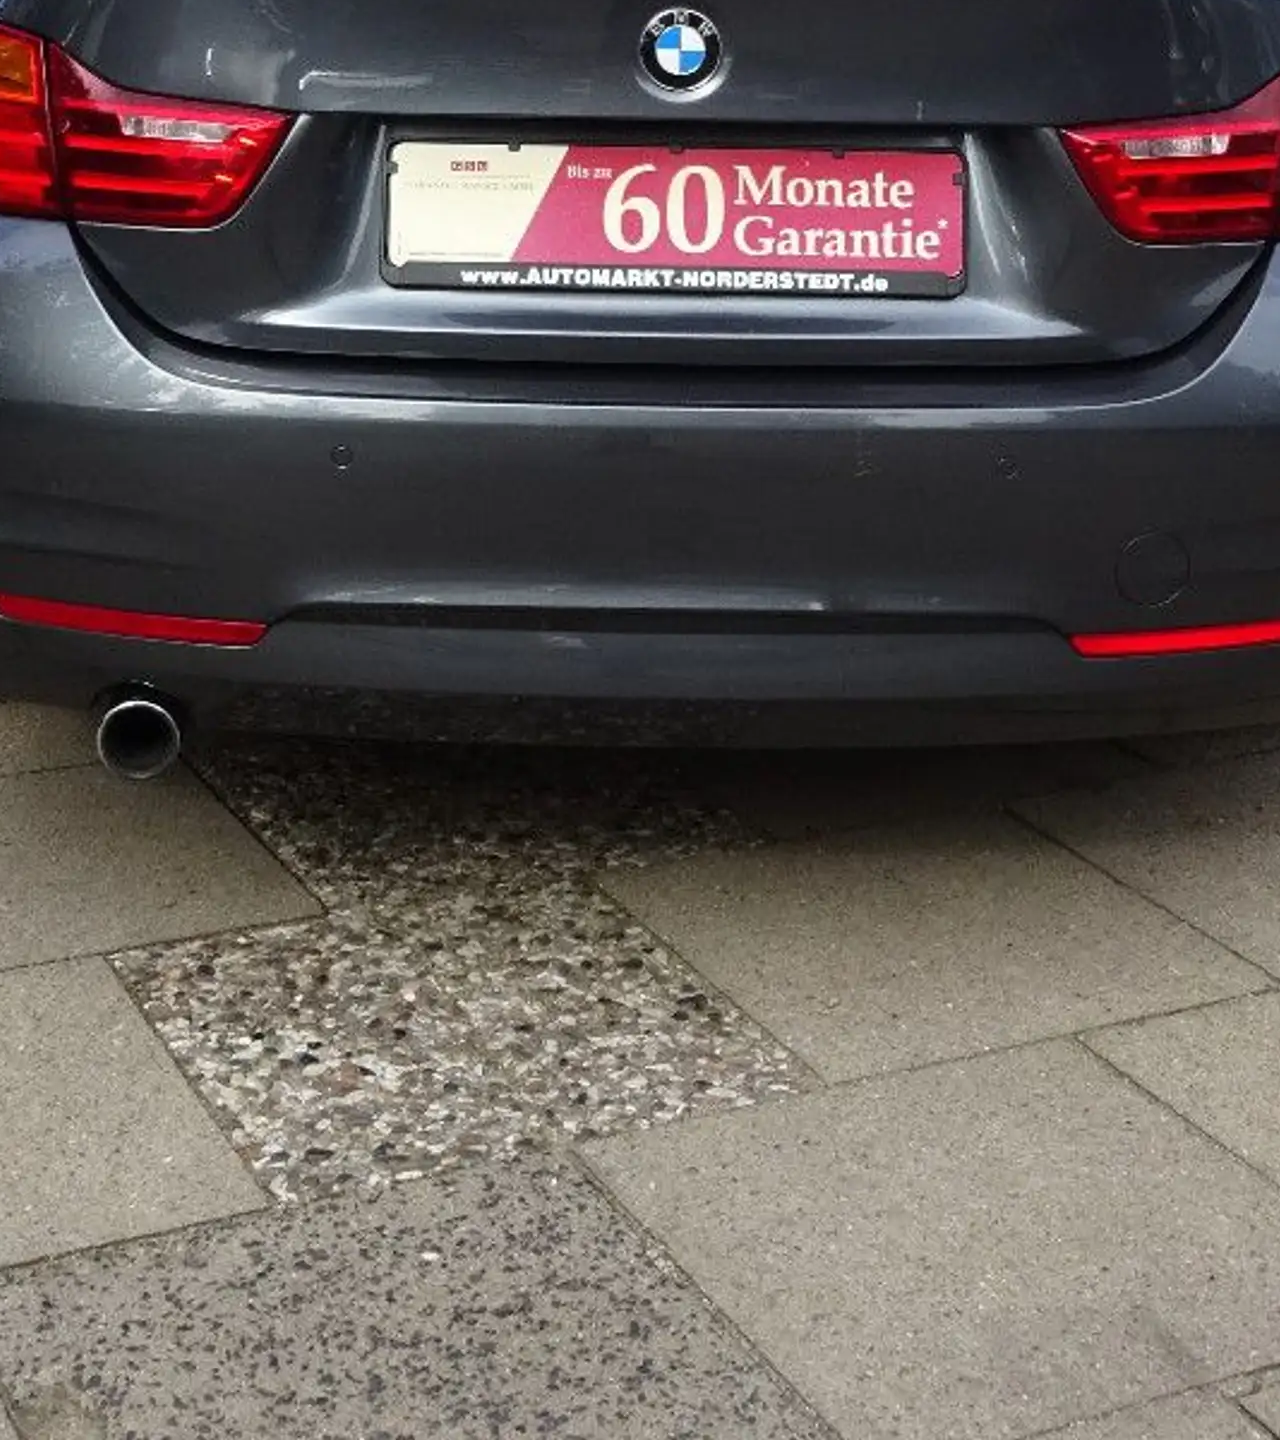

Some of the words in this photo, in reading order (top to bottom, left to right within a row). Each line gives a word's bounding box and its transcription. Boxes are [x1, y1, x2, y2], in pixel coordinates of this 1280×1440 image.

[566, 164, 590, 179] Bis
[732, 164, 915, 209] Monate
[602, 162, 726, 254] 60
[460, 267, 889, 293] www.AUTOMARKT-NORDERSTEDT.de
